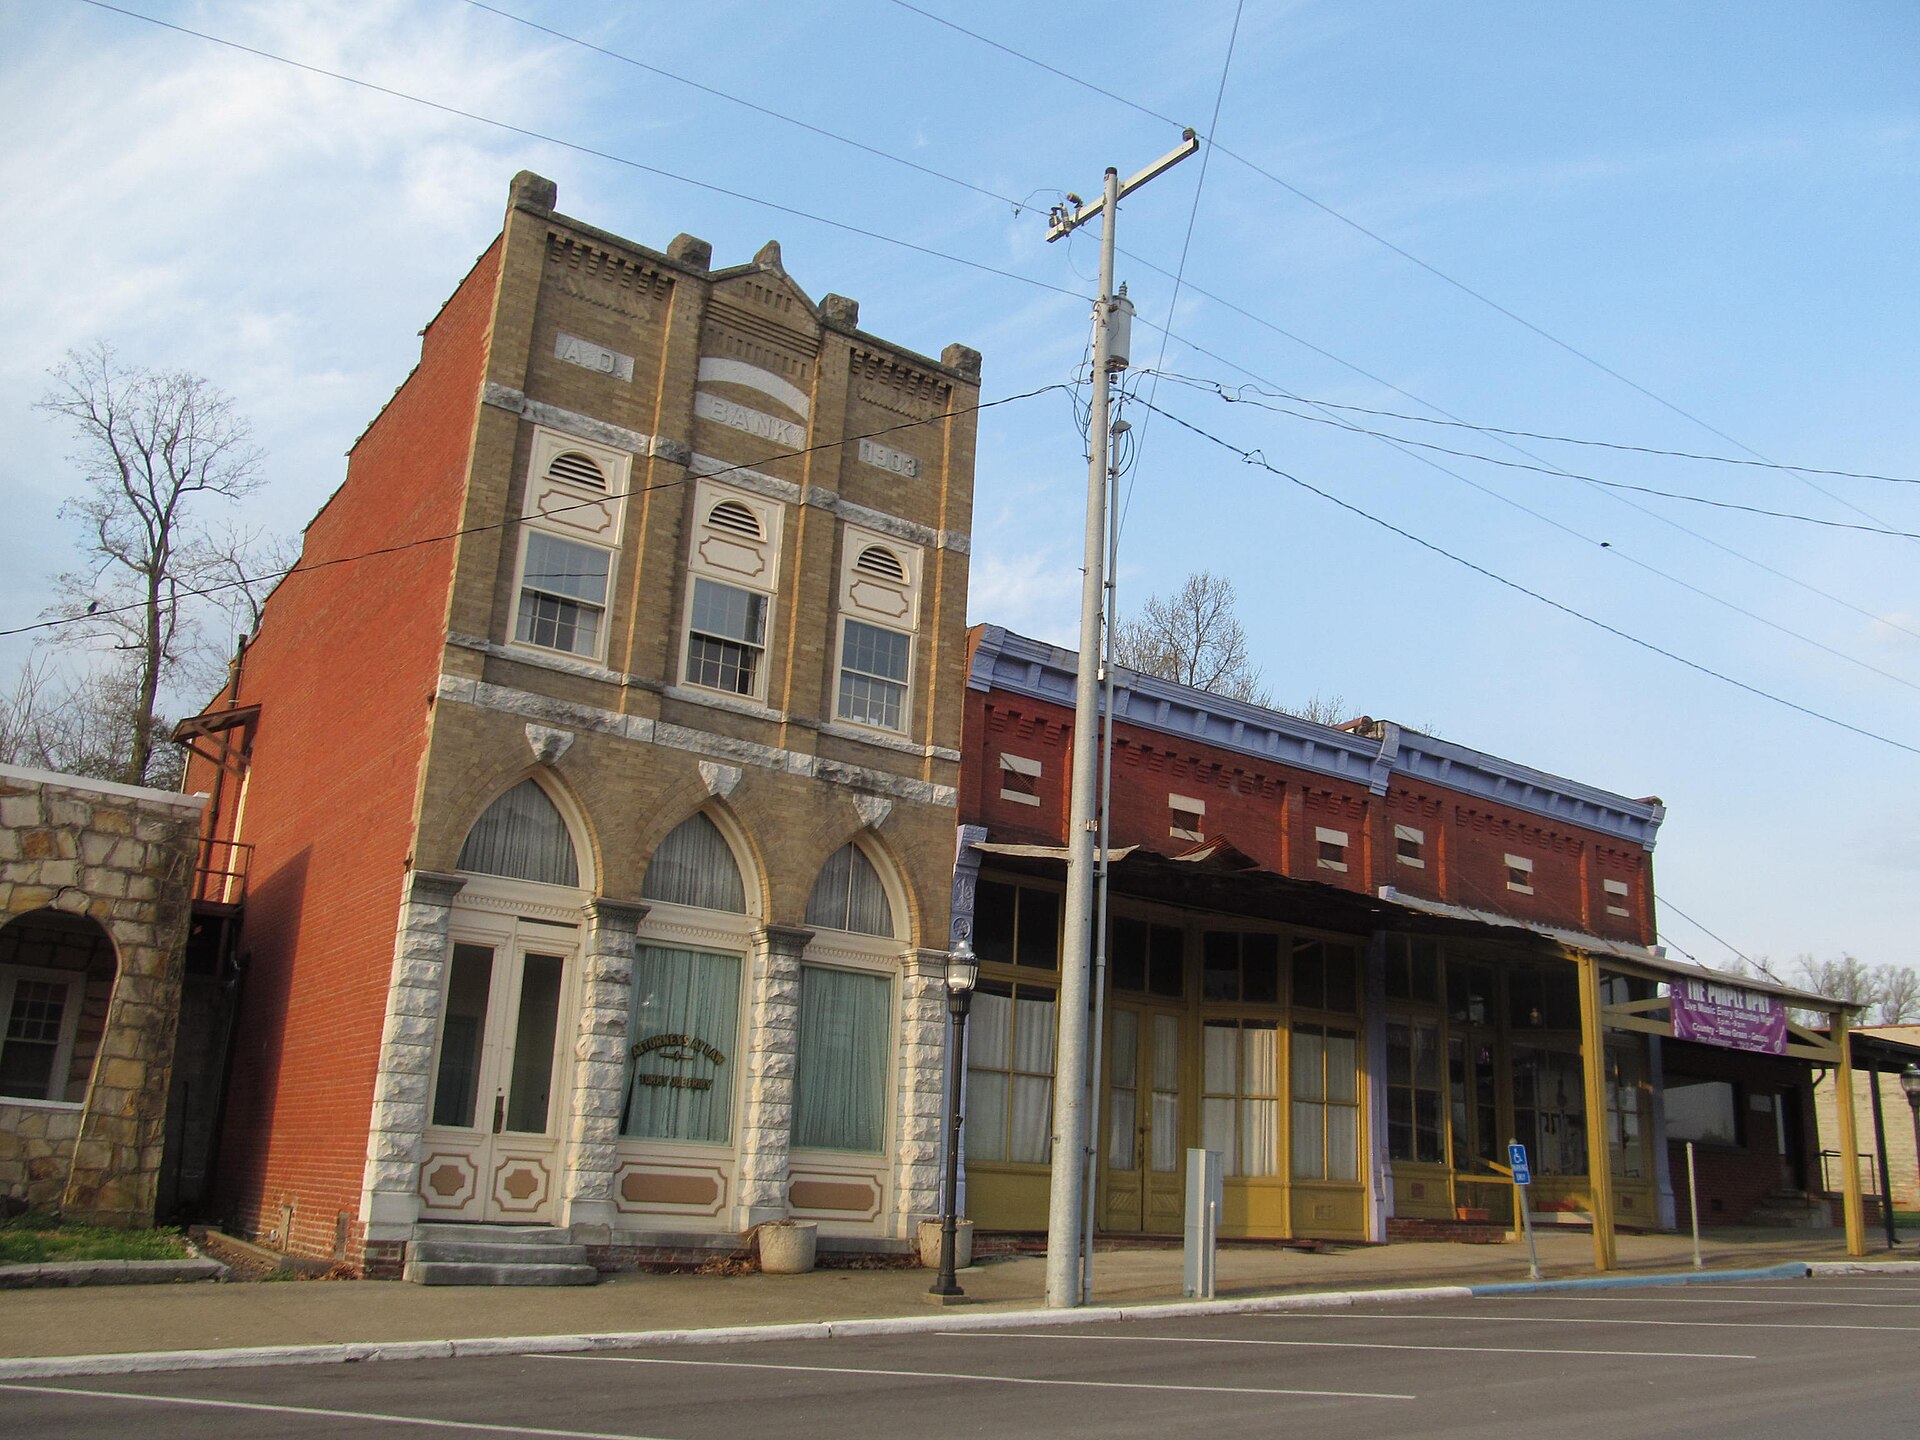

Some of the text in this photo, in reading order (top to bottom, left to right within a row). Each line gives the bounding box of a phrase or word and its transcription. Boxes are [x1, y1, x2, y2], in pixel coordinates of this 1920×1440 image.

[710, 400, 791, 445] BANK
[1687, 979, 1705, 1002] THE
[1707, 983, 1744, 1009] PURPLE
[1684, 1001, 1775, 1026] Live Music Every Saturday Night
[1693, 1023, 1715, 1036] Country
[1719, 1027, 1732, 1037] Blue
[1732, 1029, 1748, 1039] Grass
[631, 1033, 726, 1066] ATTORNEYS AT LAW
